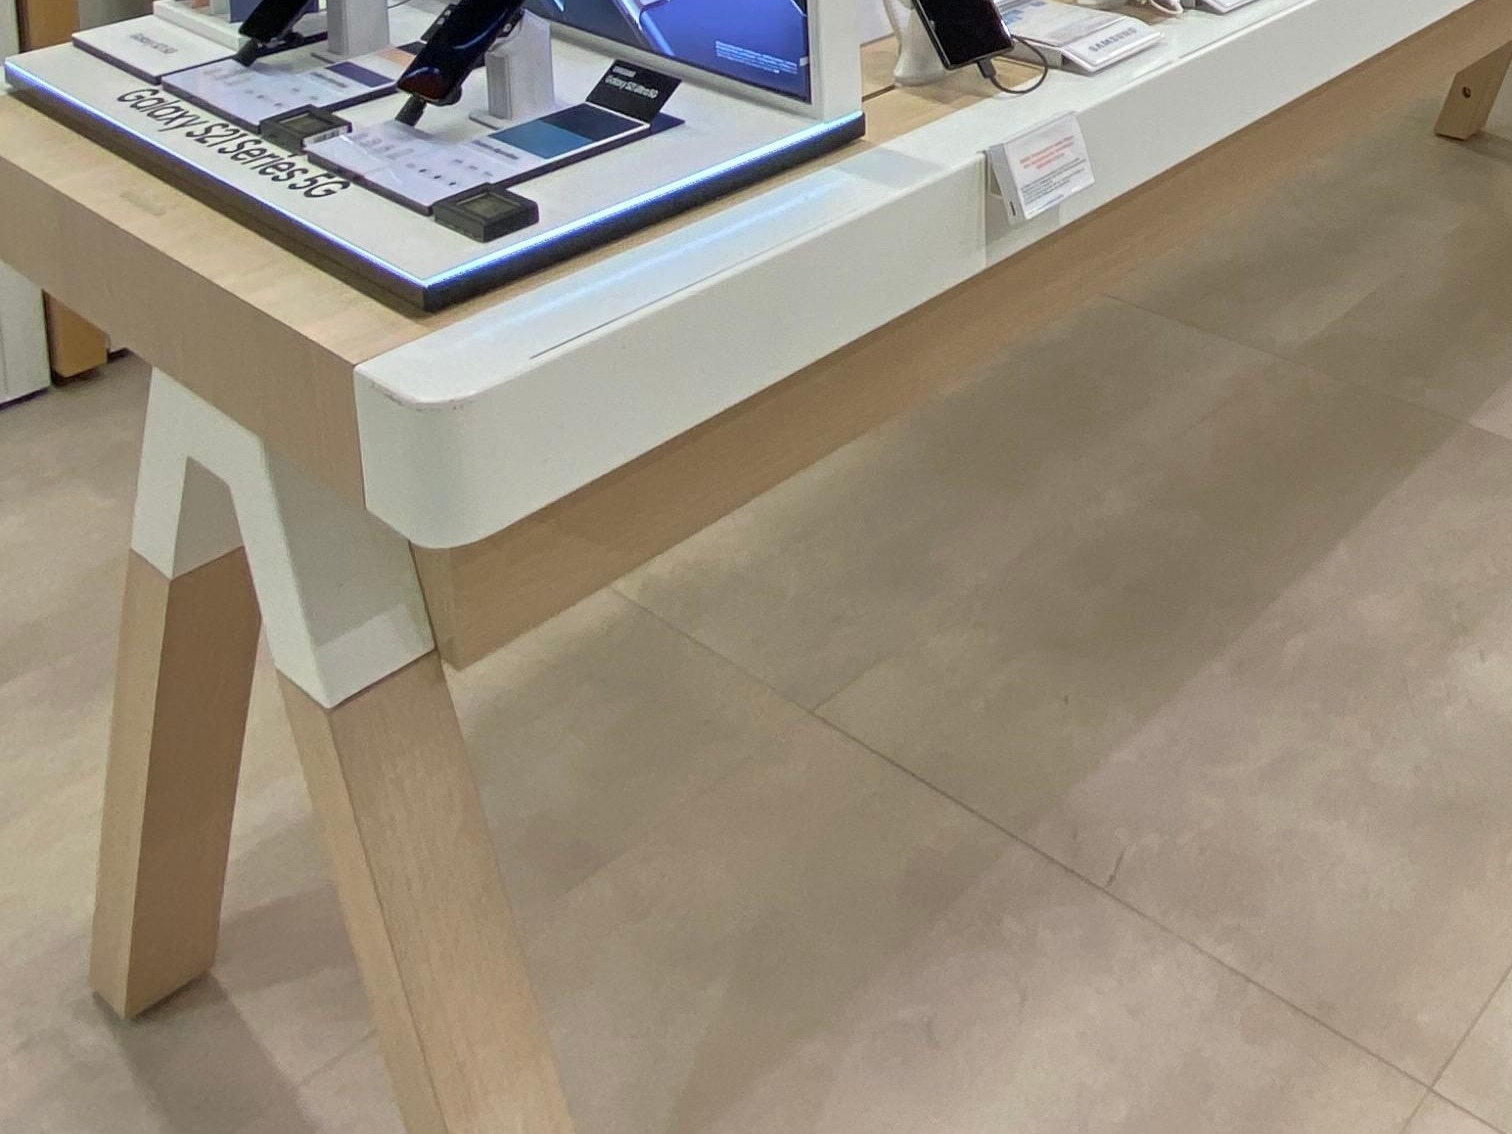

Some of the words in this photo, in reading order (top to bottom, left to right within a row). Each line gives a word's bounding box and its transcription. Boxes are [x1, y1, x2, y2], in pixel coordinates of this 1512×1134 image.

[1088, 26, 1138, 53] SAMSUNG
[116, 88, 203, 132] Galaxy
[185, 121, 246, 148] S21
[287, 170, 350, 199] 5G
